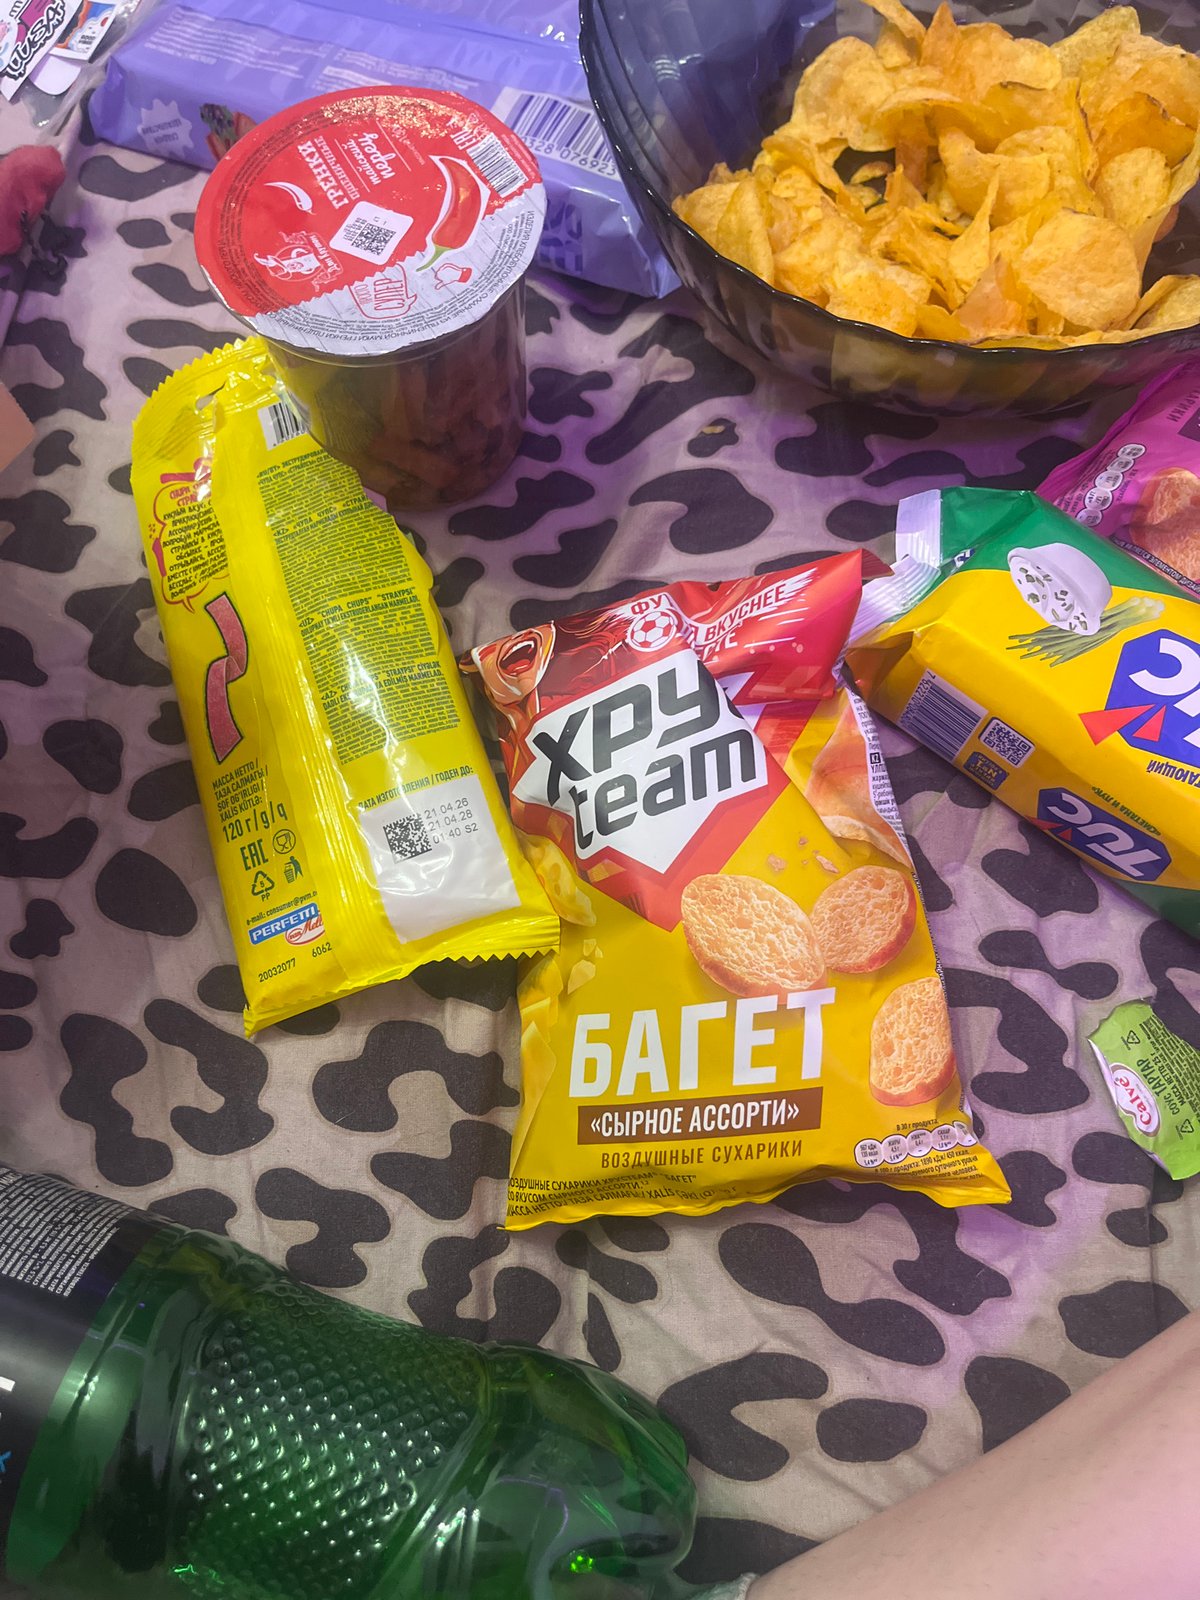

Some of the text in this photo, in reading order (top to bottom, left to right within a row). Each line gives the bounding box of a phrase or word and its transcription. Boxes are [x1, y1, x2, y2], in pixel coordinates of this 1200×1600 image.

[358, 132, 396, 179] перец
[297, 140, 349, 209] ГРЕНКИ
[343, 496, 368, 507] «СТРАЙ
[704, 582, 786, 643] ВКУСНЕЕ
[213, 773, 234, 790] МАССА
[235, 761, 254, 778] НЕТТО
[436, 768, 459, 783] ГОДЕН
[460, 766, 473, 777] ДО:
[568, 729, 756, 850] team
[424, 797, 469, 819] 21.04.26
[428, 809, 473, 832] 21.04.28
[223, 819, 243, 843] 120
[465, 822, 478, 833] S2
[1047, 792, 1161, 878] TUC
[261, 893, 270, 901] PP
[252, 906, 316, 941] PERFETTI
[259, 942, 332, 982] 20032077 6062
[568, 988, 836, 1099] БАГЕТ
[1152, 1056, 1161, 1067] 25
[1136, 1059, 1168, 1097] ТАРТАР
[1164, 1092, 1180, 1115] СОУС
[1171, 1087, 1187, 1107] МАССА
[590, 1099, 800, 1137] «СЫРНОЕ АССОРТИ»
[601, 1140, 802, 1169] ВОЗДУШНЫЕ СУХАРИКИ
[552, 1179, 601, 1191] СУХАРИКИ
